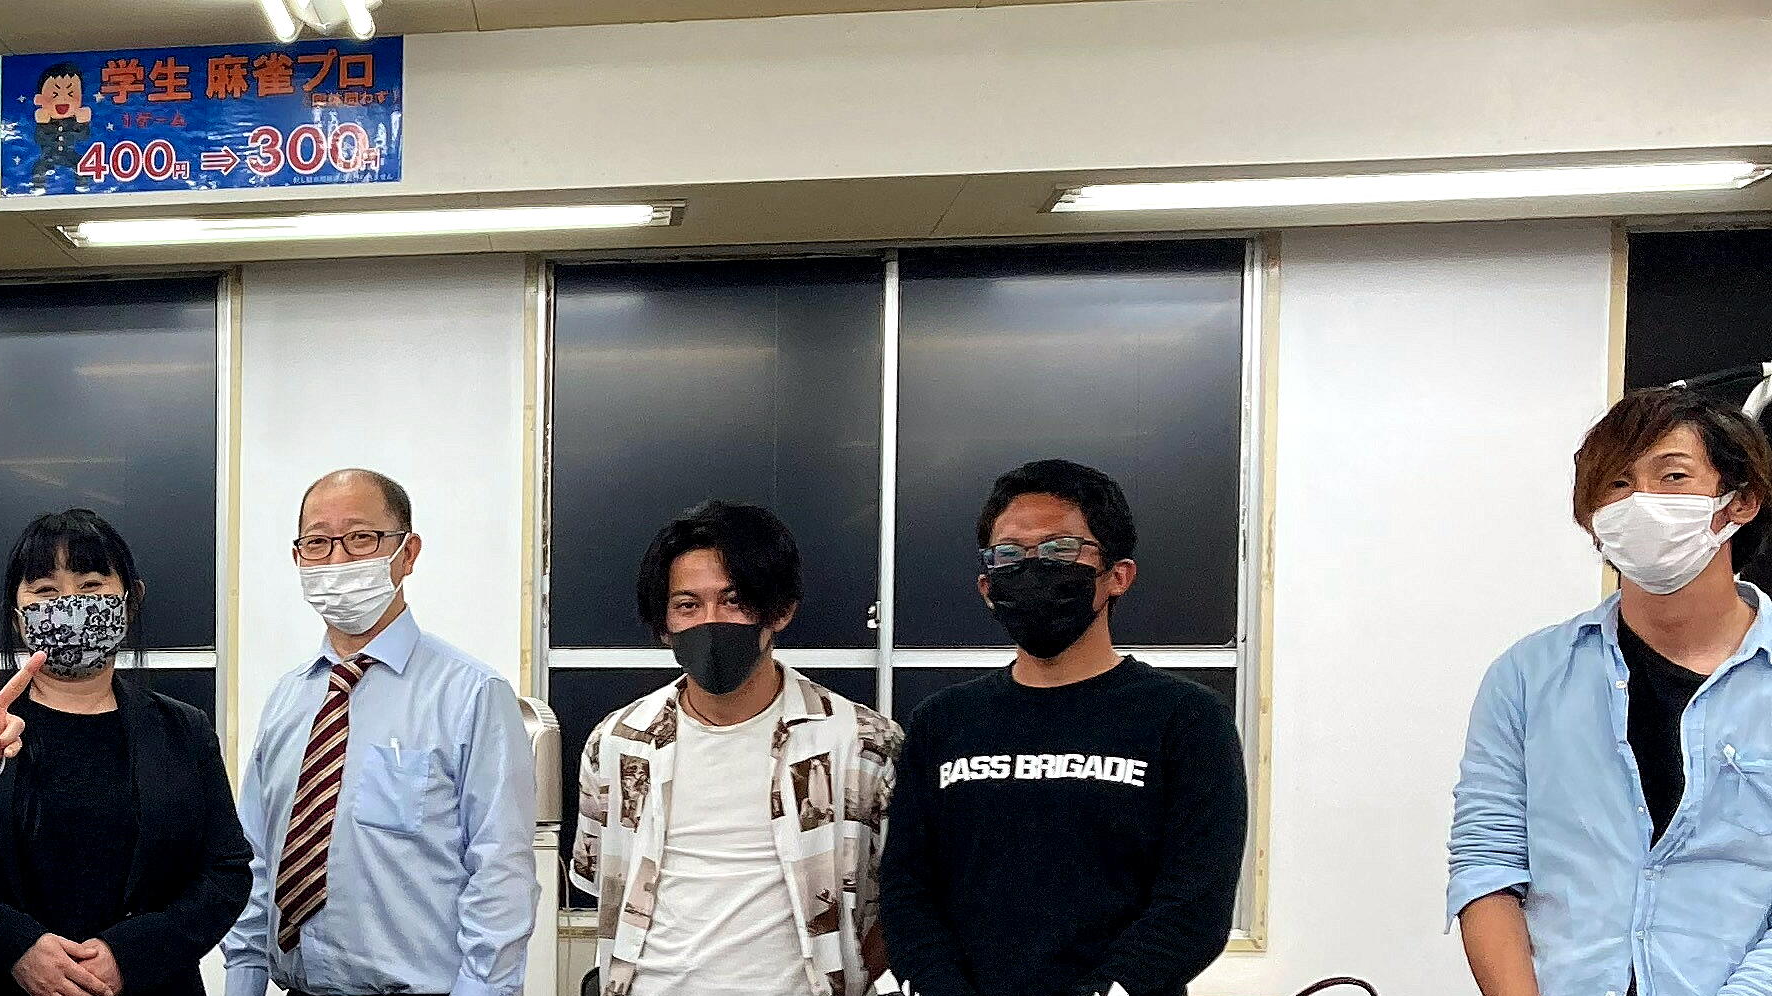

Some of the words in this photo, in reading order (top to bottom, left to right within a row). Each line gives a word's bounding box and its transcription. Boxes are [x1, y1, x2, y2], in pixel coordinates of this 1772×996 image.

[100, 56, 192, 104] 学生
[205, 49, 375, 100] 麻雀プロ
[77, 139, 190, 183] 400円
[246, 122, 380, 177] 300円
[939, 755, 1012, 788] BASS
[1014, 753, 1149, 787] BRIGADE
